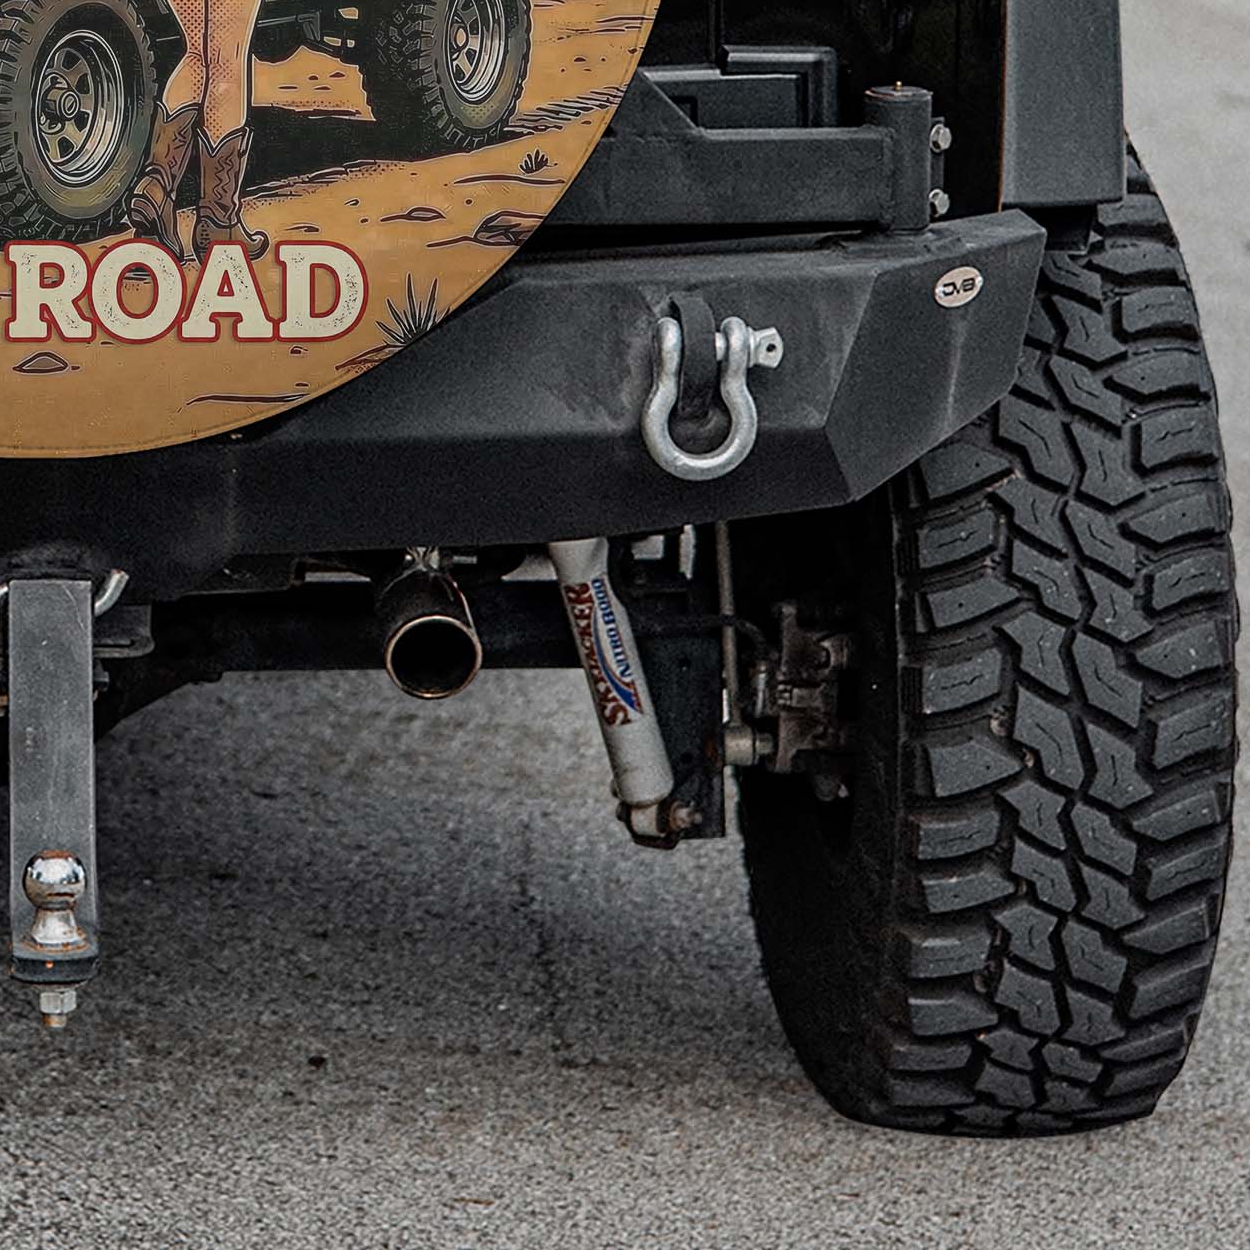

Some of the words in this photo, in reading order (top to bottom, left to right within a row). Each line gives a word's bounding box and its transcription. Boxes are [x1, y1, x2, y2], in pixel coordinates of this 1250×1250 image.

[5, 238, 367, 344] ROAD
[563, 582, 632, 726] SKYJACKER
[607, 626, 633, 677] NITRO
